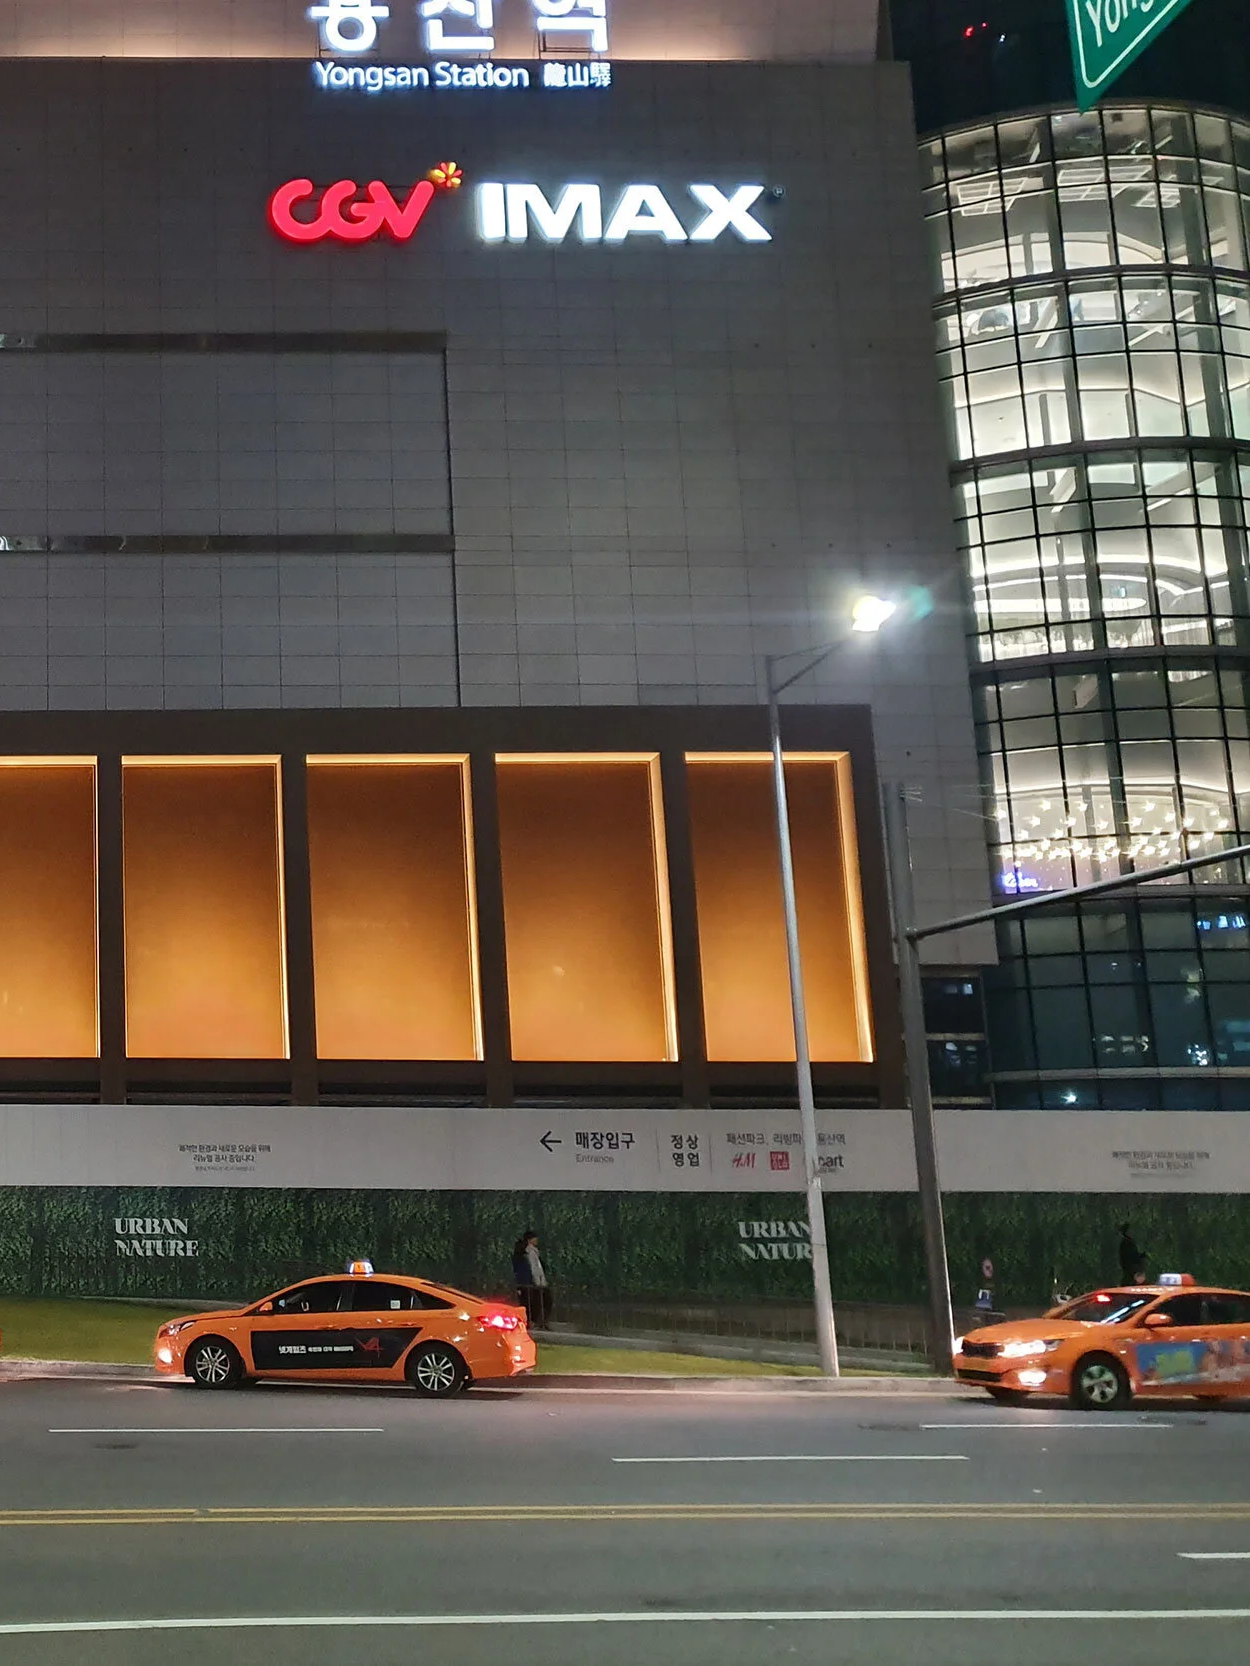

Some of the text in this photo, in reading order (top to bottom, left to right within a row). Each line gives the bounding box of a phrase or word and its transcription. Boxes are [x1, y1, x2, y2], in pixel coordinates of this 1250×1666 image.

[317, 61, 529, 91] Yongsan Station
[271, 178, 773, 241] CGV IMAX
[575, 1132, 635, 1149] 매장입구
[671, 1134, 698, 1150] 정상
[672, 1152, 699, 1167] 영업
[114, 1217, 188, 1234] URBAN
[114, 1240, 198, 1257] NATURE
[739, 1243, 812, 1260] NATUR
